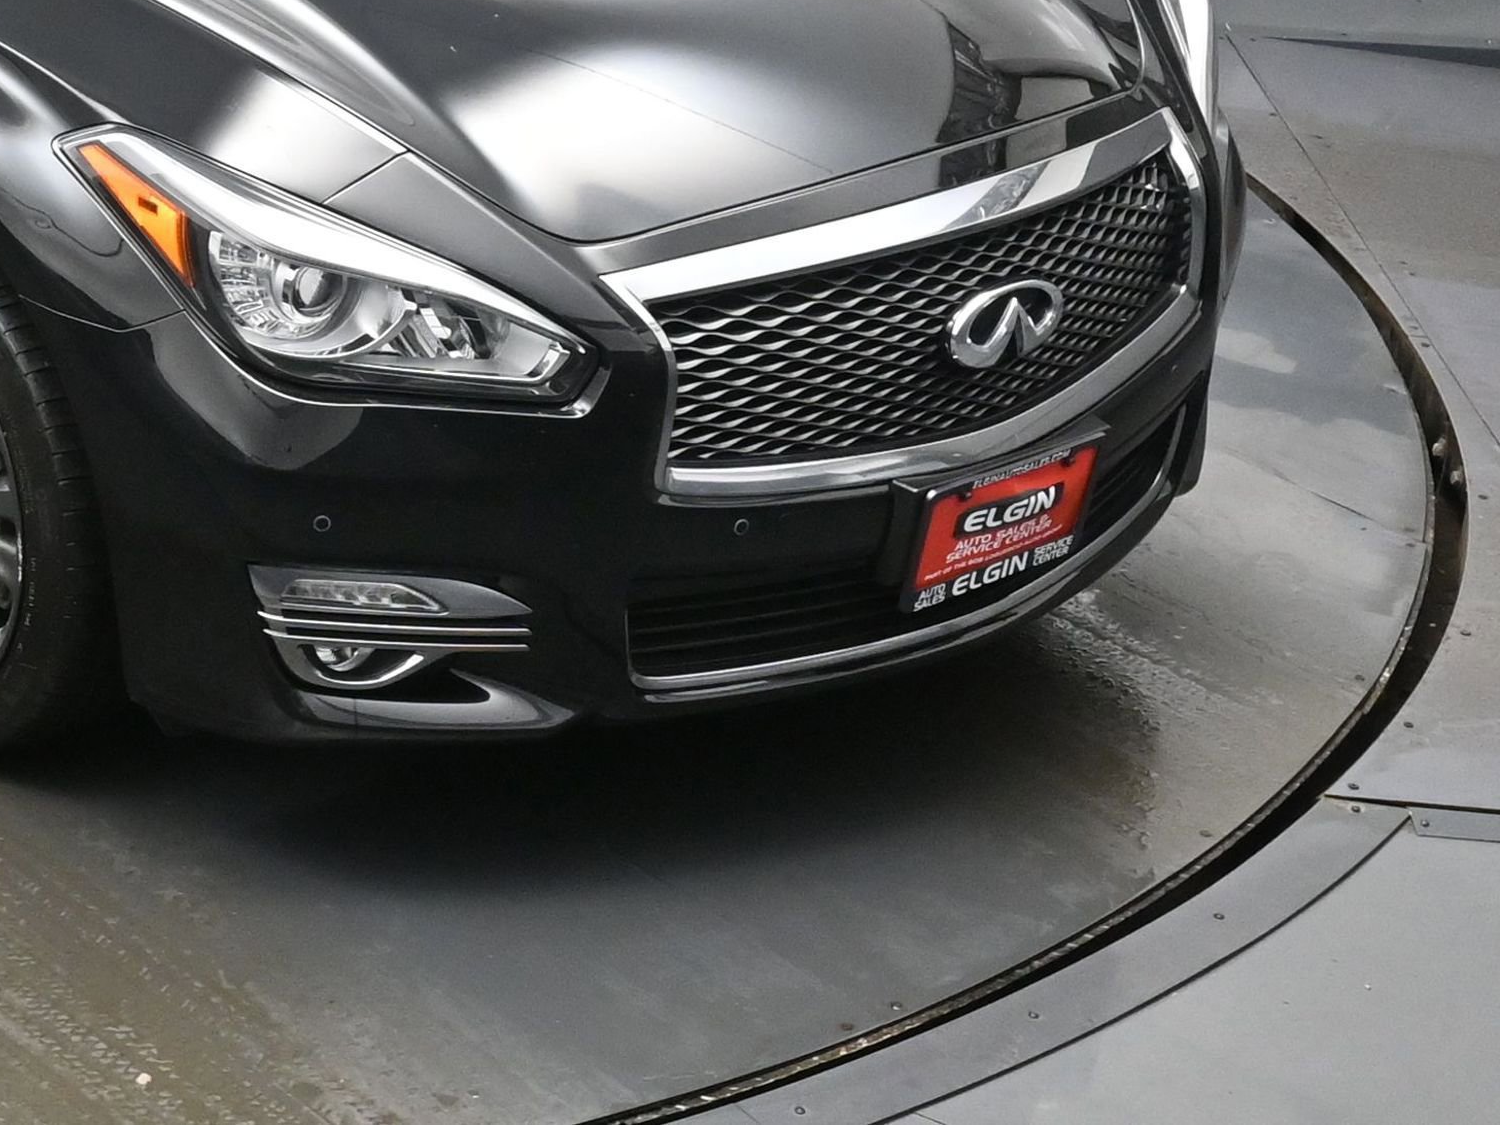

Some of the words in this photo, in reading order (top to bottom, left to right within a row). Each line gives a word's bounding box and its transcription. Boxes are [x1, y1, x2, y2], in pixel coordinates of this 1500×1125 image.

[963, 485, 1056, 533] ELGIN
[946, 536, 1003, 564] SERVICE
[1005, 519, 1052, 544] CENTER
[954, 533, 992, 551] AUTO
[996, 518, 1037, 542] SALES
[1034, 535, 1074, 556] SERVICE
[1032, 546, 1069, 566] CENTER
[952, 551, 1029, 596] ELGIN
[913, 593, 946, 612] SALES
[918, 583, 946, 602] AUTO
